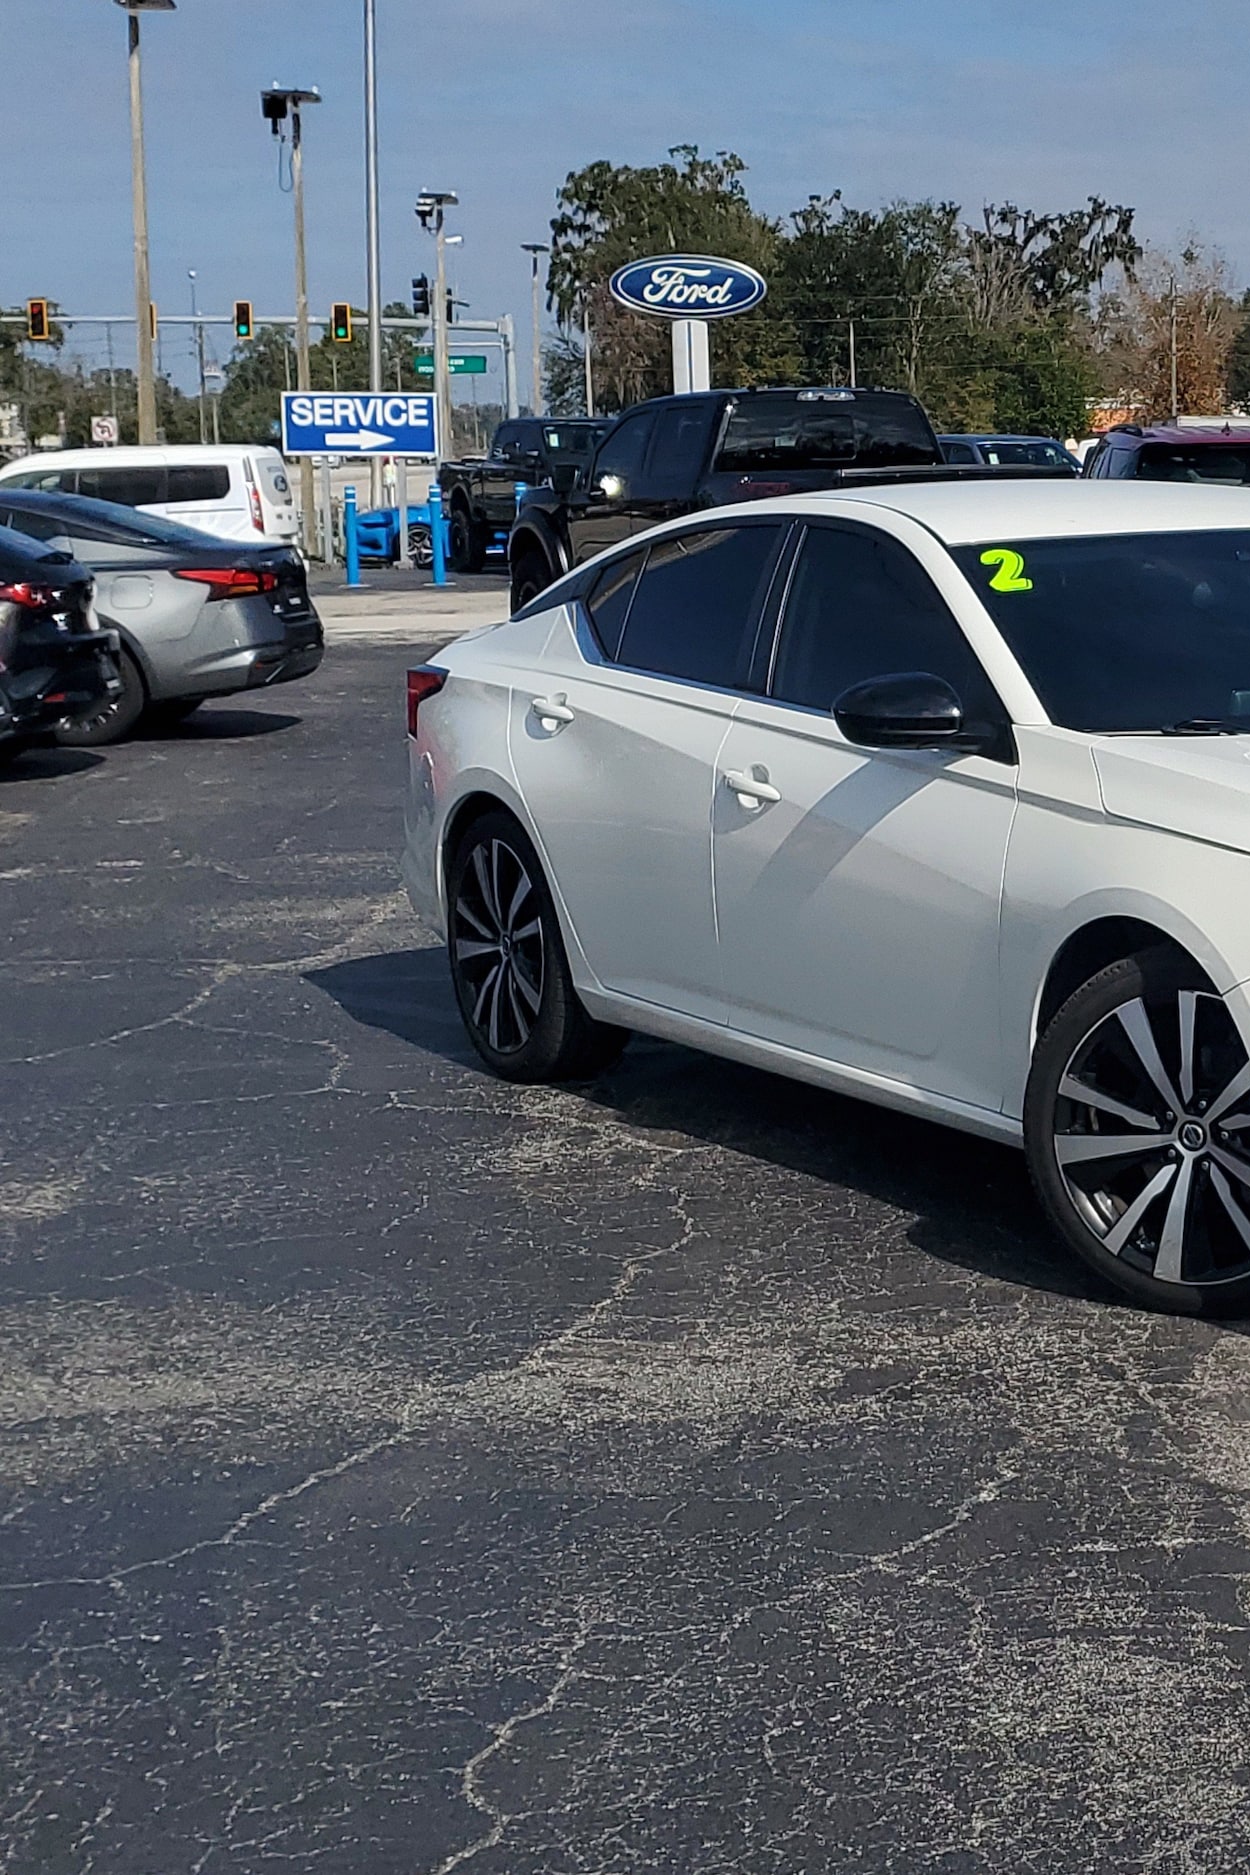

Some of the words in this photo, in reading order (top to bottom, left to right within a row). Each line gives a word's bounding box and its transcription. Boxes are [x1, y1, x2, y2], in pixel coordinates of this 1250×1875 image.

[643, 266, 734, 304] Ford
[291, 397, 429, 427] SERVICE
[980, 549, 1033, 592] 2
